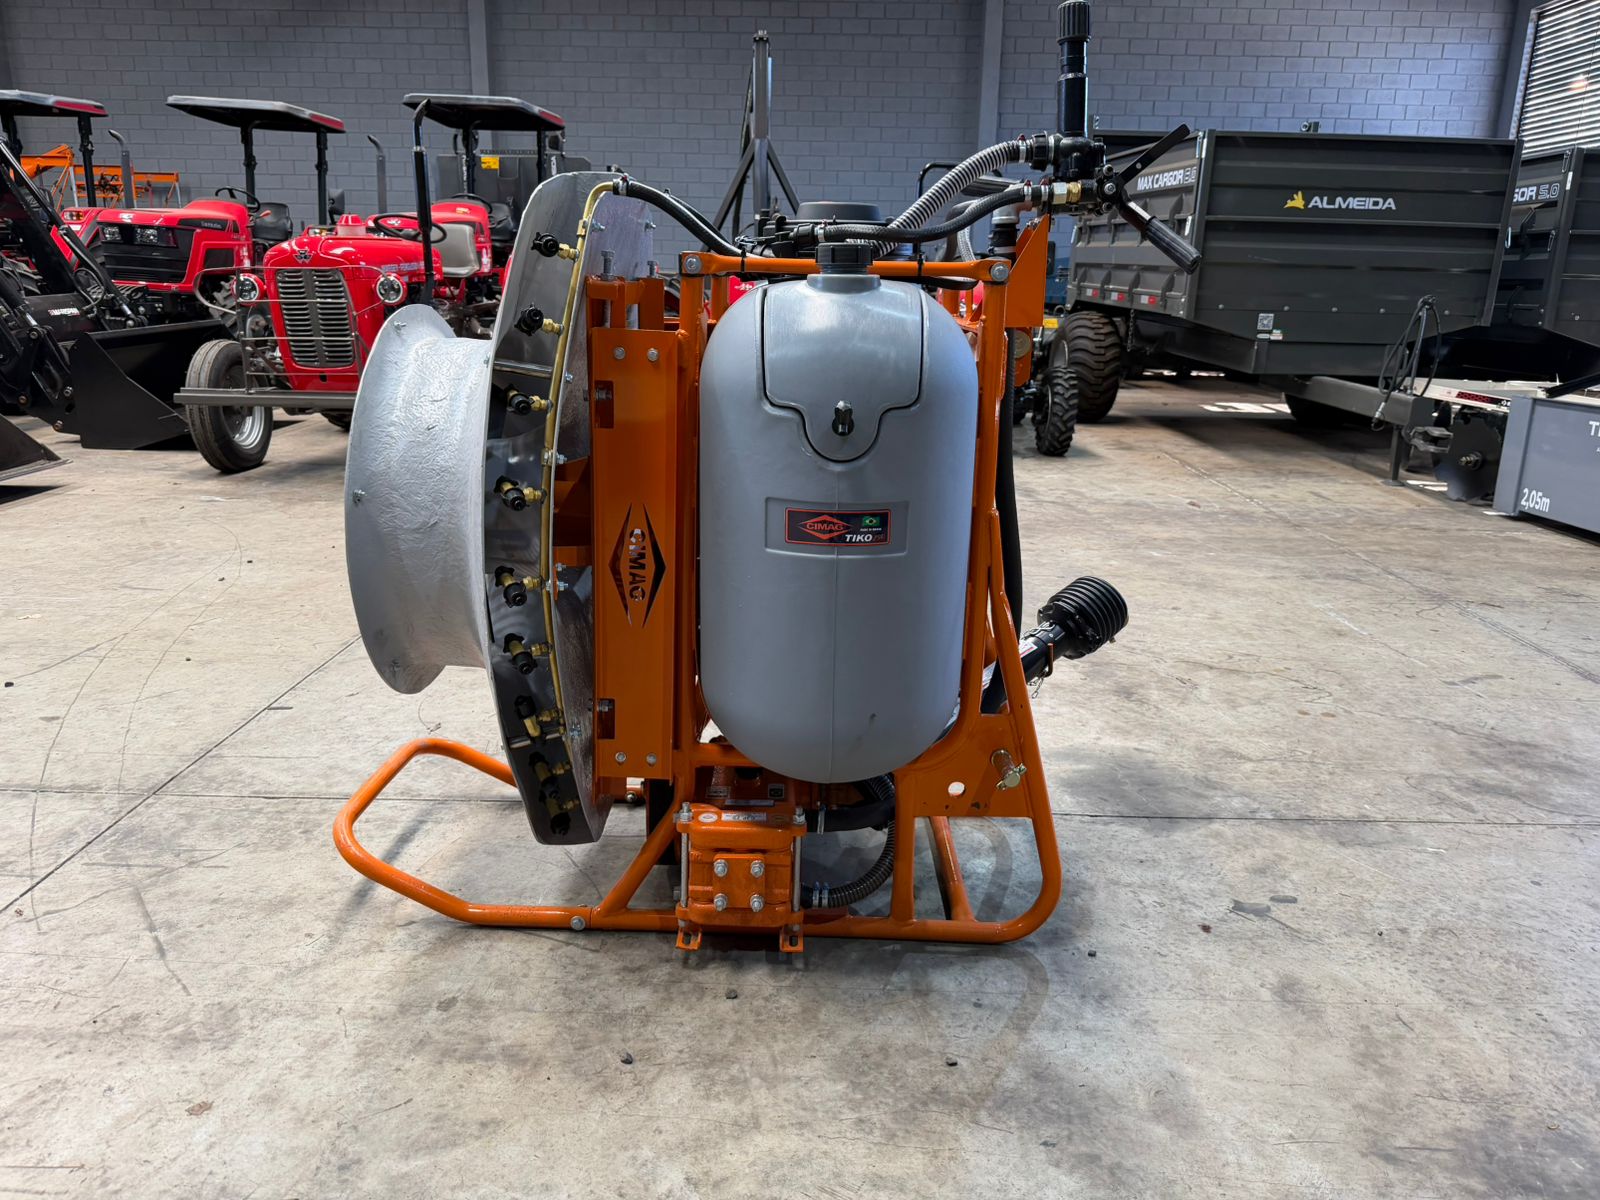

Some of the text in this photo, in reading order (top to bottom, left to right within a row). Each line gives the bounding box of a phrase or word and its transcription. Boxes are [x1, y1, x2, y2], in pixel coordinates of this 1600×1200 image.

[1137, 175, 1154, 191] MAX
[1153, 169, 1184, 188] CARGOR
[1538, 183, 1560, 200] 5.0
[1307, 195, 1397, 211] ALMEIDA
[1520, 487, 1551, 513] 2,05m
[806, 522, 844, 531] CIMAG
[844, 533, 873, 543] TIKO
[628, 528, 647, 603] CIMAG
